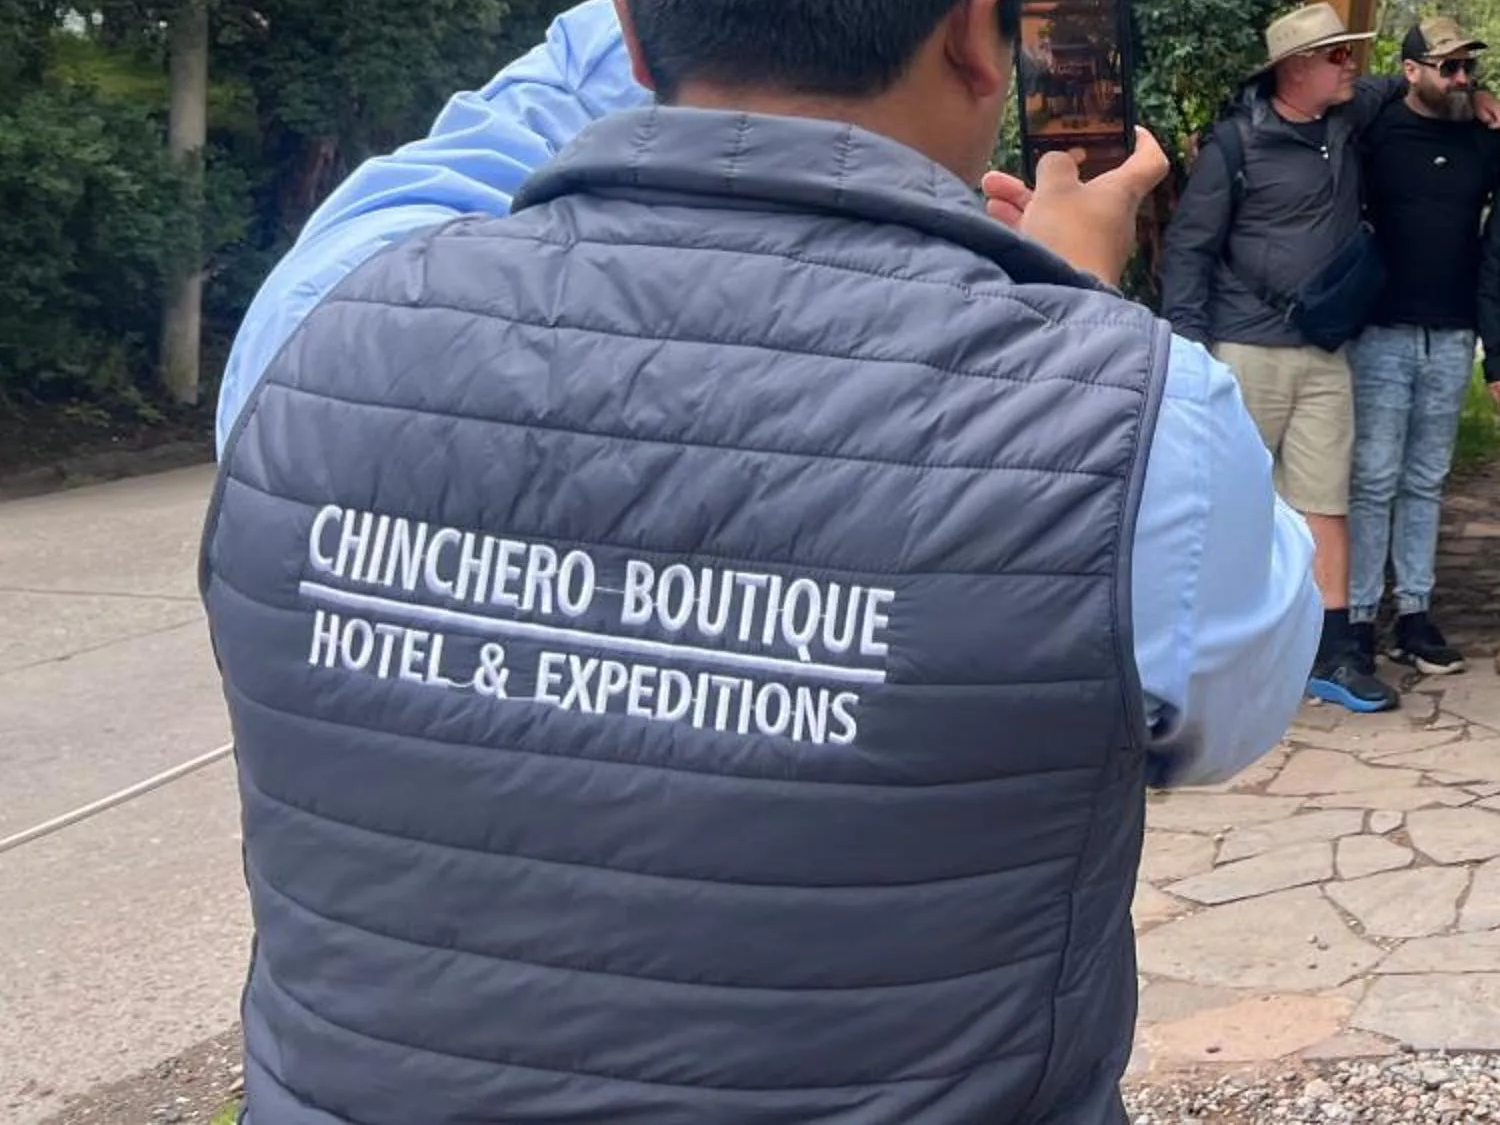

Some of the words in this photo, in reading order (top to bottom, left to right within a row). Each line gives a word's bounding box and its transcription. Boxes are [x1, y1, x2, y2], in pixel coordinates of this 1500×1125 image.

[308, 504, 596, 617] CHINCHERO
[620, 560, 896, 661] BOUTIQUE
[308, 610, 446, 687] HOTEL
[473, 642, 508, 699] &
[534, 651, 859, 744] EXPEDITIONS
